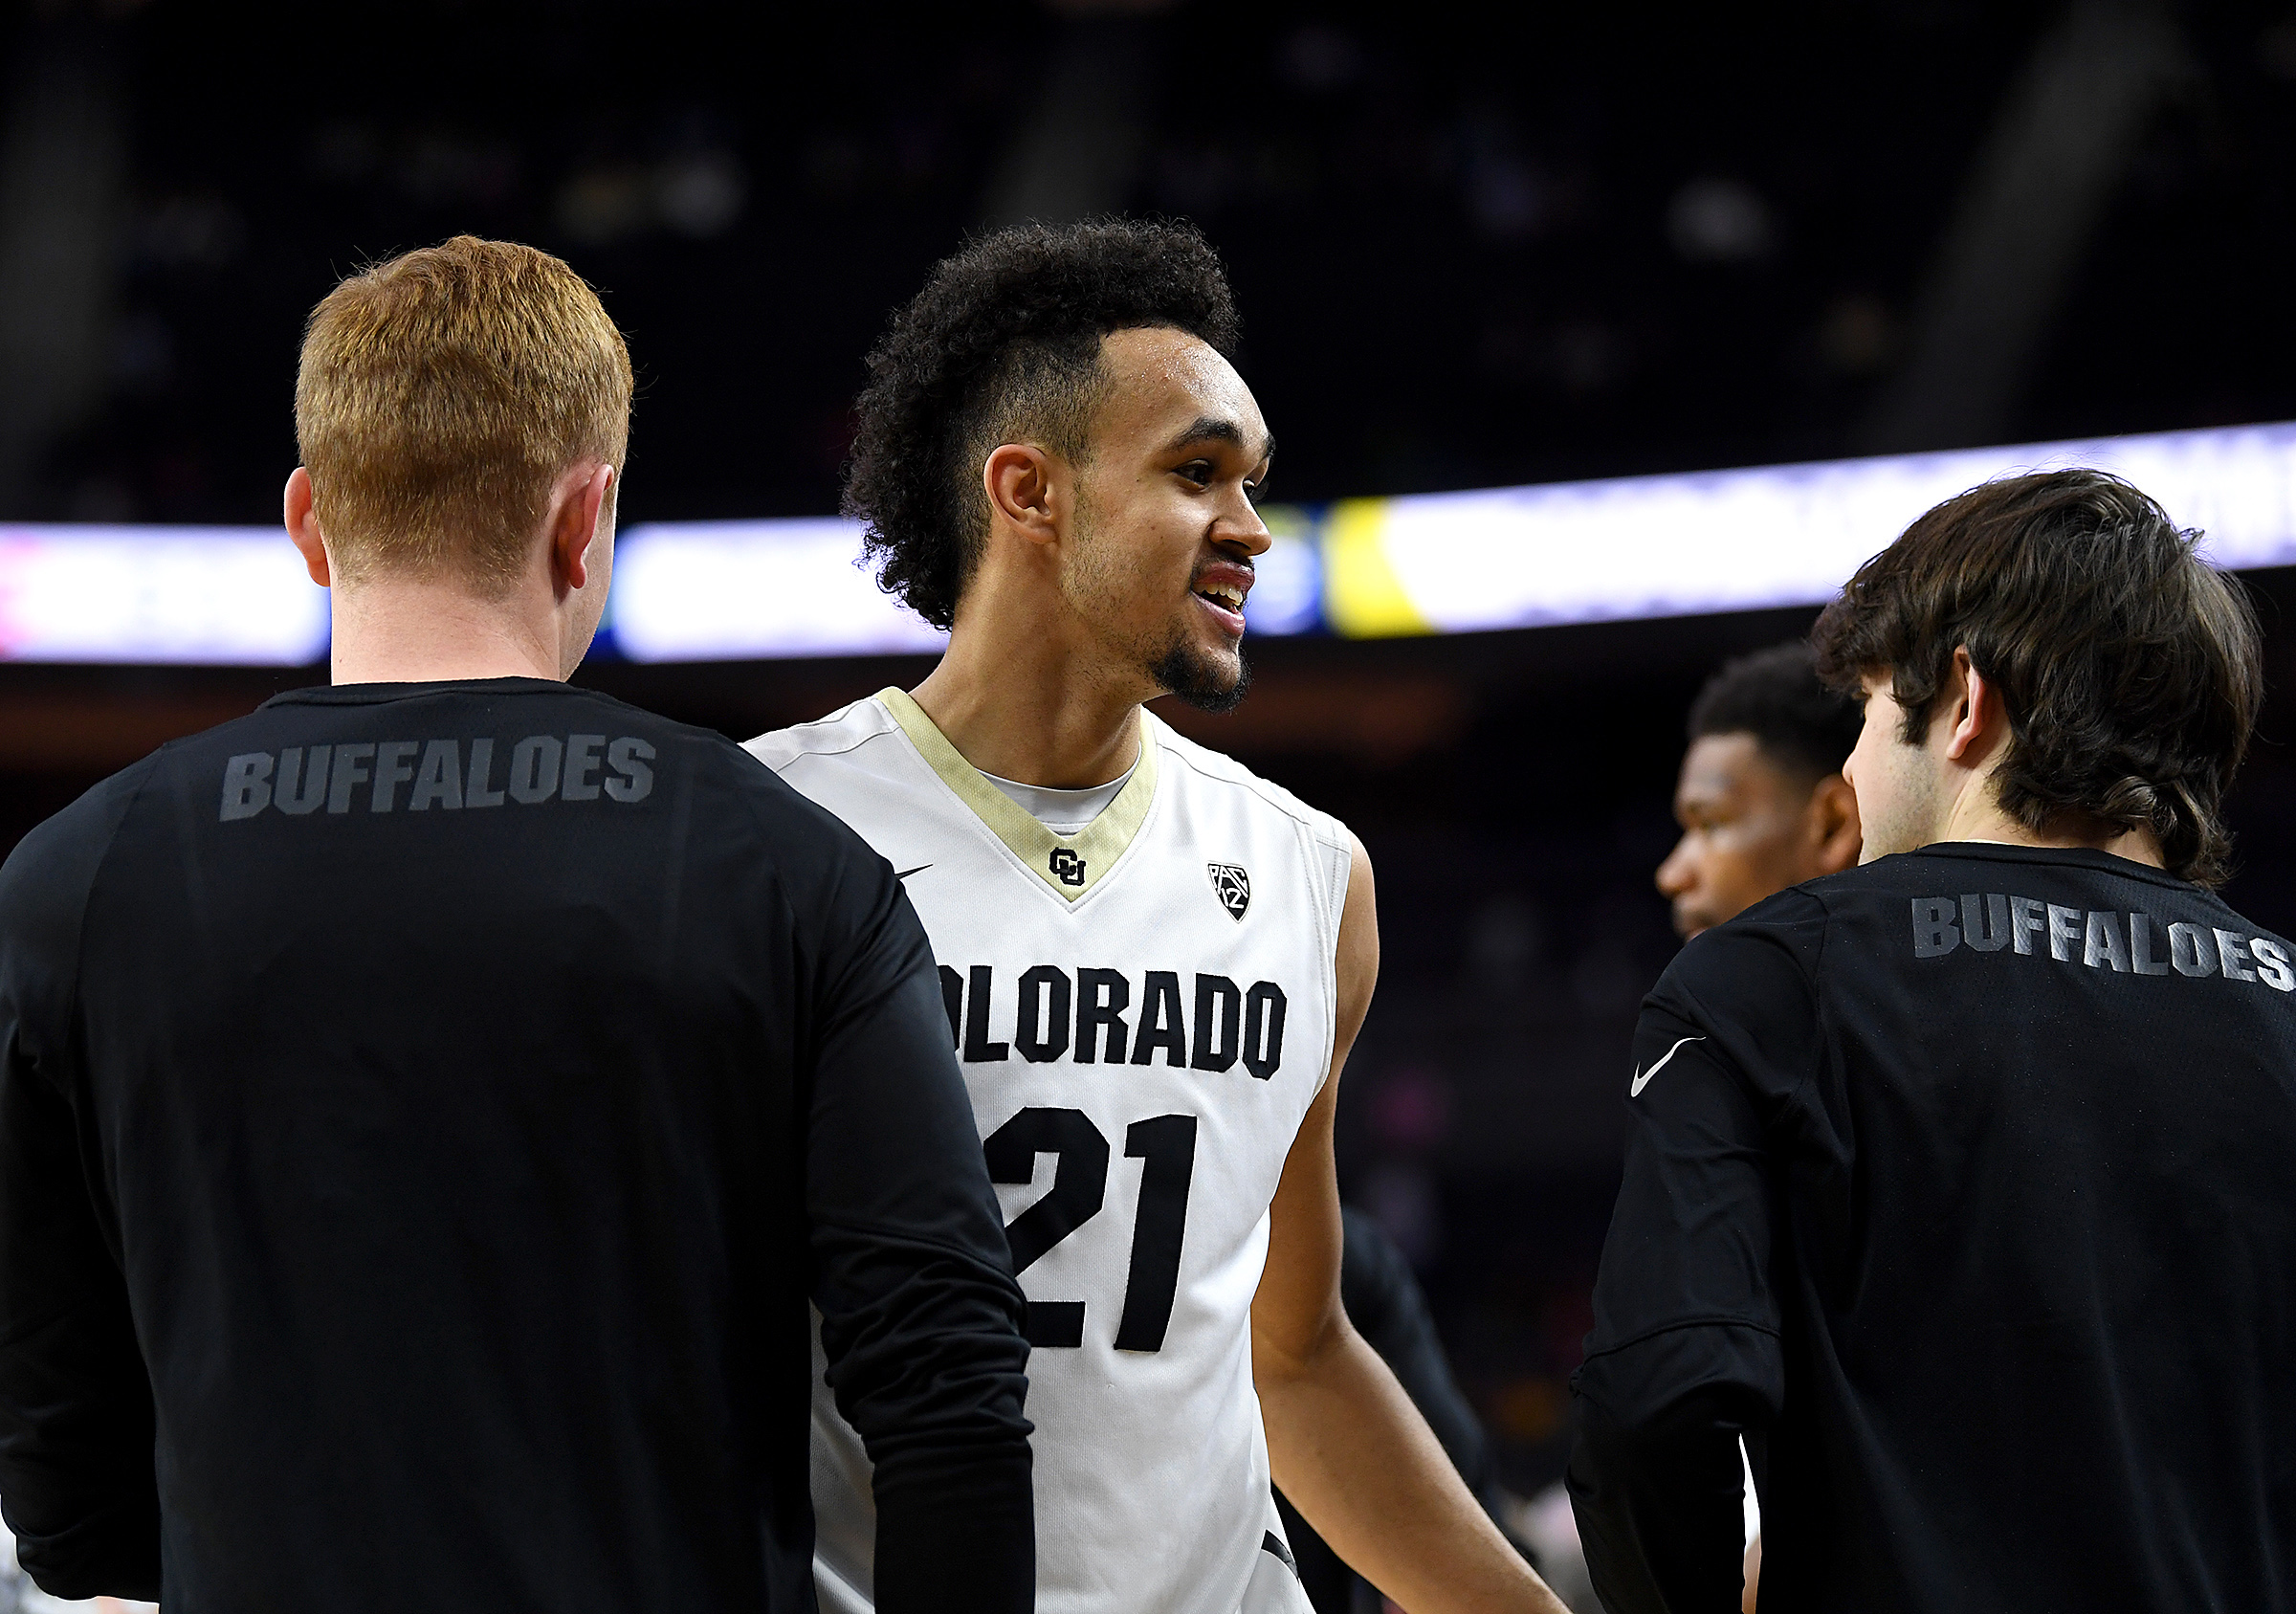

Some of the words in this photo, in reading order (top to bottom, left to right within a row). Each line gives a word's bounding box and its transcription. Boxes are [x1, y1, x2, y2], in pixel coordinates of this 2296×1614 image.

[219, 734, 656, 823] BUFFALOES
[1911, 894, 2296, 993] BUFFALOES
[983, 1106, 1198, 1353] 21
